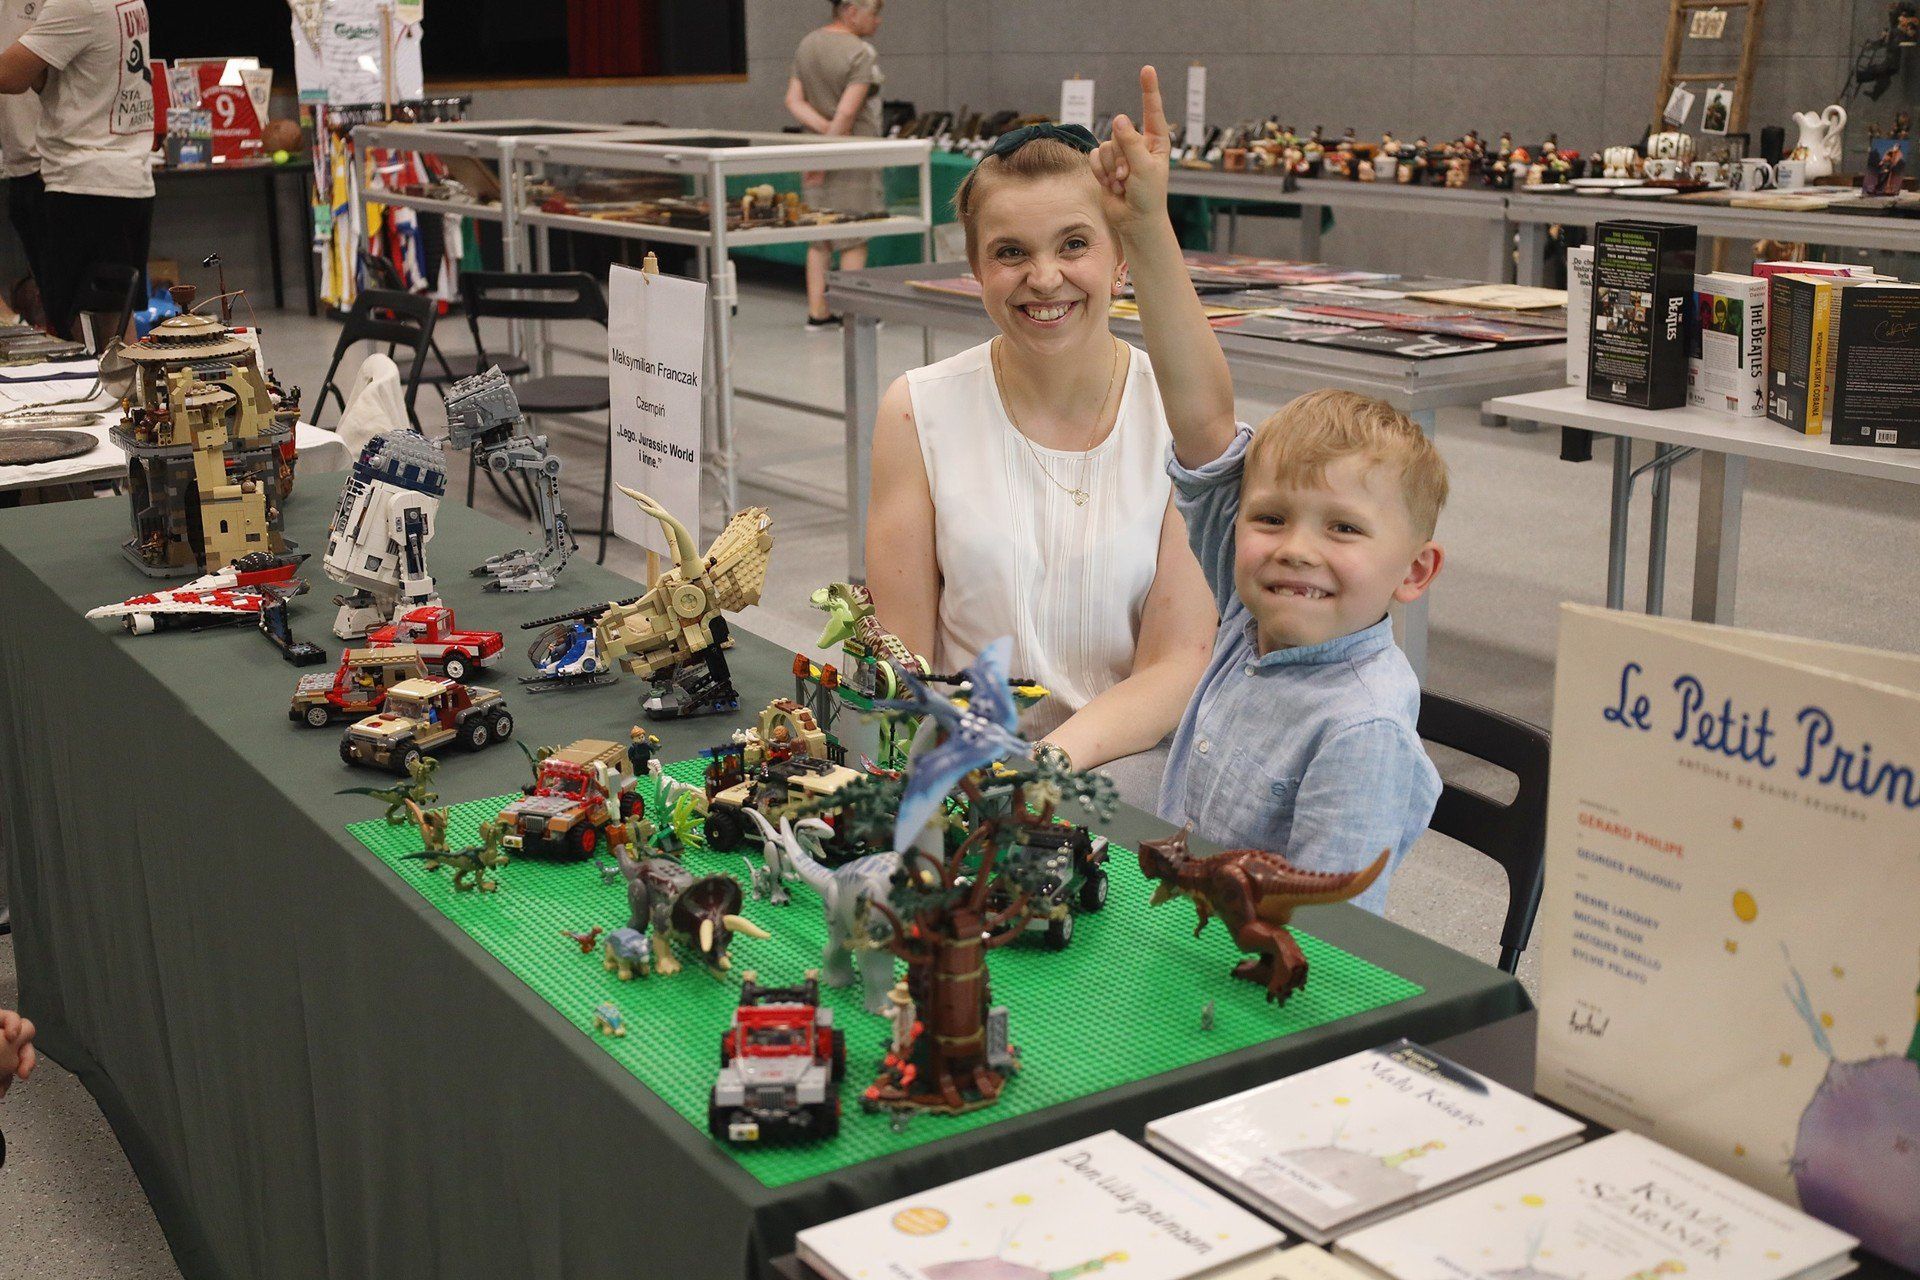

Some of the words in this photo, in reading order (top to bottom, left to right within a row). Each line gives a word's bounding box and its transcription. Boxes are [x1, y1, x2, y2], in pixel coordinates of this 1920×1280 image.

[216, 94, 235, 128] 9
[1665, 296, 1684, 340] BEATLES
[1750, 302, 1765, 326] THE
[612, 347, 655, 375] Maksymilian
[657, 362, 698, 387] Franczak
[1747, 326, 1767, 378] BEATLES
[635, 395, 665, 418] Czempiń
[638, 432, 668, 454] Jurassic
[669, 442, 695, 463] World
[1603, 662, 1652, 730] Le
[1673, 674, 1776, 768] Petit
[1796, 705, 1920, 809] Prin
